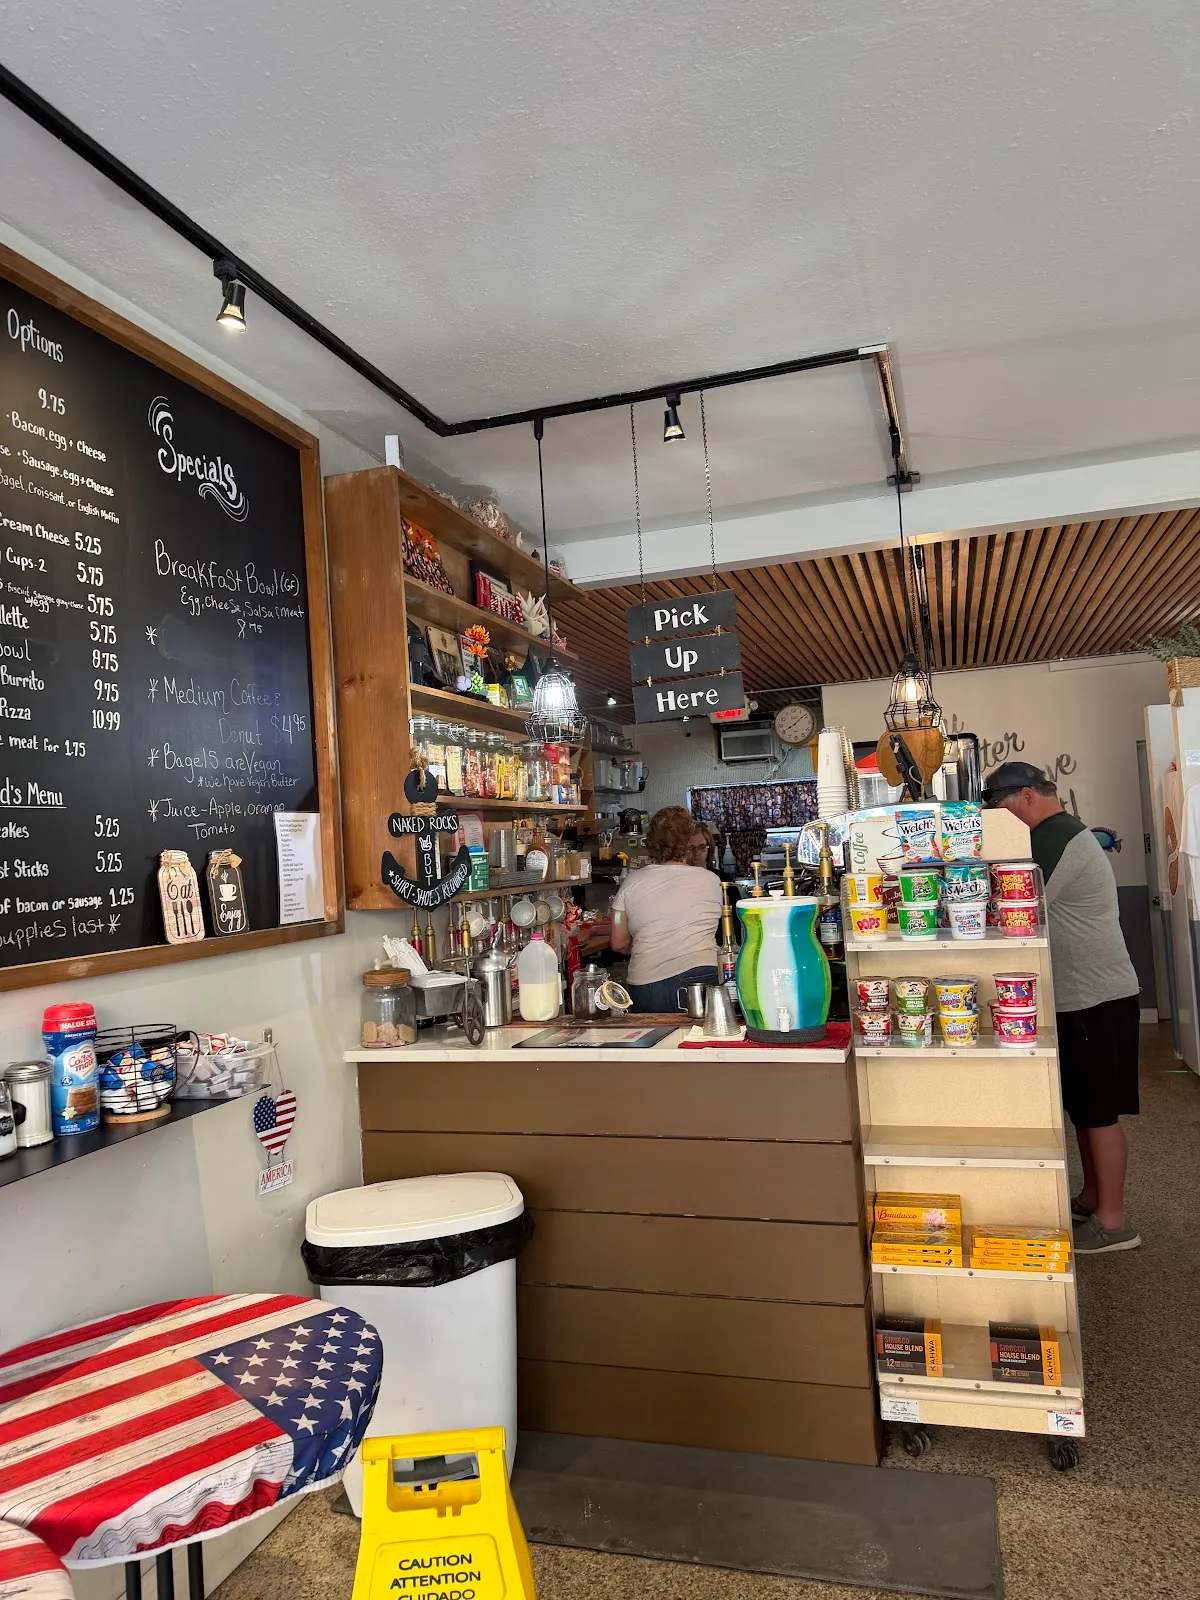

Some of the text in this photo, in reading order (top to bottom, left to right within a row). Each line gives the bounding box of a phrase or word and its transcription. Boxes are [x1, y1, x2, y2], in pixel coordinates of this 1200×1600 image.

[7, 308, 64, 363] Options
[38, 388, 66, 416] 9.75
[76, 440, 107, 462] Cheese
[154, 408, 243, 503] Specials
[77, 498, 100, 517] English
[100, 509, 120, 525] Muffin
[35, 523, 71, 546] Cheese
[74, 531, 102, 555] 5.25
[76, 561, 104, 587] 5.75
[244, 561, 279, 595] Bowl
[87, 593, 114, 617] 5.75
[653, 603, 710, 632] Pick
[89, 620, 117, 644] 5.75
[92, 649, 119, 672] 8.75
[664, 646, 699, 673] Up
[0, 664, 120, 703] Burrito 9.75
[163, 675, 230, 715] Medium
[656, 688, 720, 713] Here
[0, 697, 121, 731] Pizza 10.99
[217, 717, 264, 747] Donut
[9, 735, 39, 750] meat
[43, 738, 60, 753] for
[64, 739, 86, 757] 1.75
[27, 782, 64, 806] Menu
[222, 773, 245, 793] have
[94, 814, 120, 838] 5.25
[187, 823, 236, 841] Tomato
[392, 816, 425, 833] NAKED
[429, 814, 459, 831] ROCKS
[900, 819, 936, 835] Welch's
[852, 831, 869, 865] Coffee
[14, 858, 50, 878] Sticks
[95, 850, 122, 873] 5.25
[16, 897, 50, 914] bacon
[52, 899, 66, 911] or
[68, 895, 103, 910] sausage
[108, 887, 135, 907] 1.25
[166, 878, 194, 901] Eat
[220, 902, 242, 931] Enjoy
[857, 918, 881, 931] POPS
[61, 1020, 85, 1030] VALUE
[260, 1163, 292, 1186] AMERICA
[884, 1343, 904, 1351] HOUSE
[928, 1339, 937, 1372] KAHWA
[999, 1351, 1040, 1361] HOUSE BLEND
[886, 1358, 896, 1368] 12
[1001, 1367, 1010, 1377] 12
[398, 1553, 473, 1571] CAUTION
[390, 1570, 481, 1590] ATTENTION
